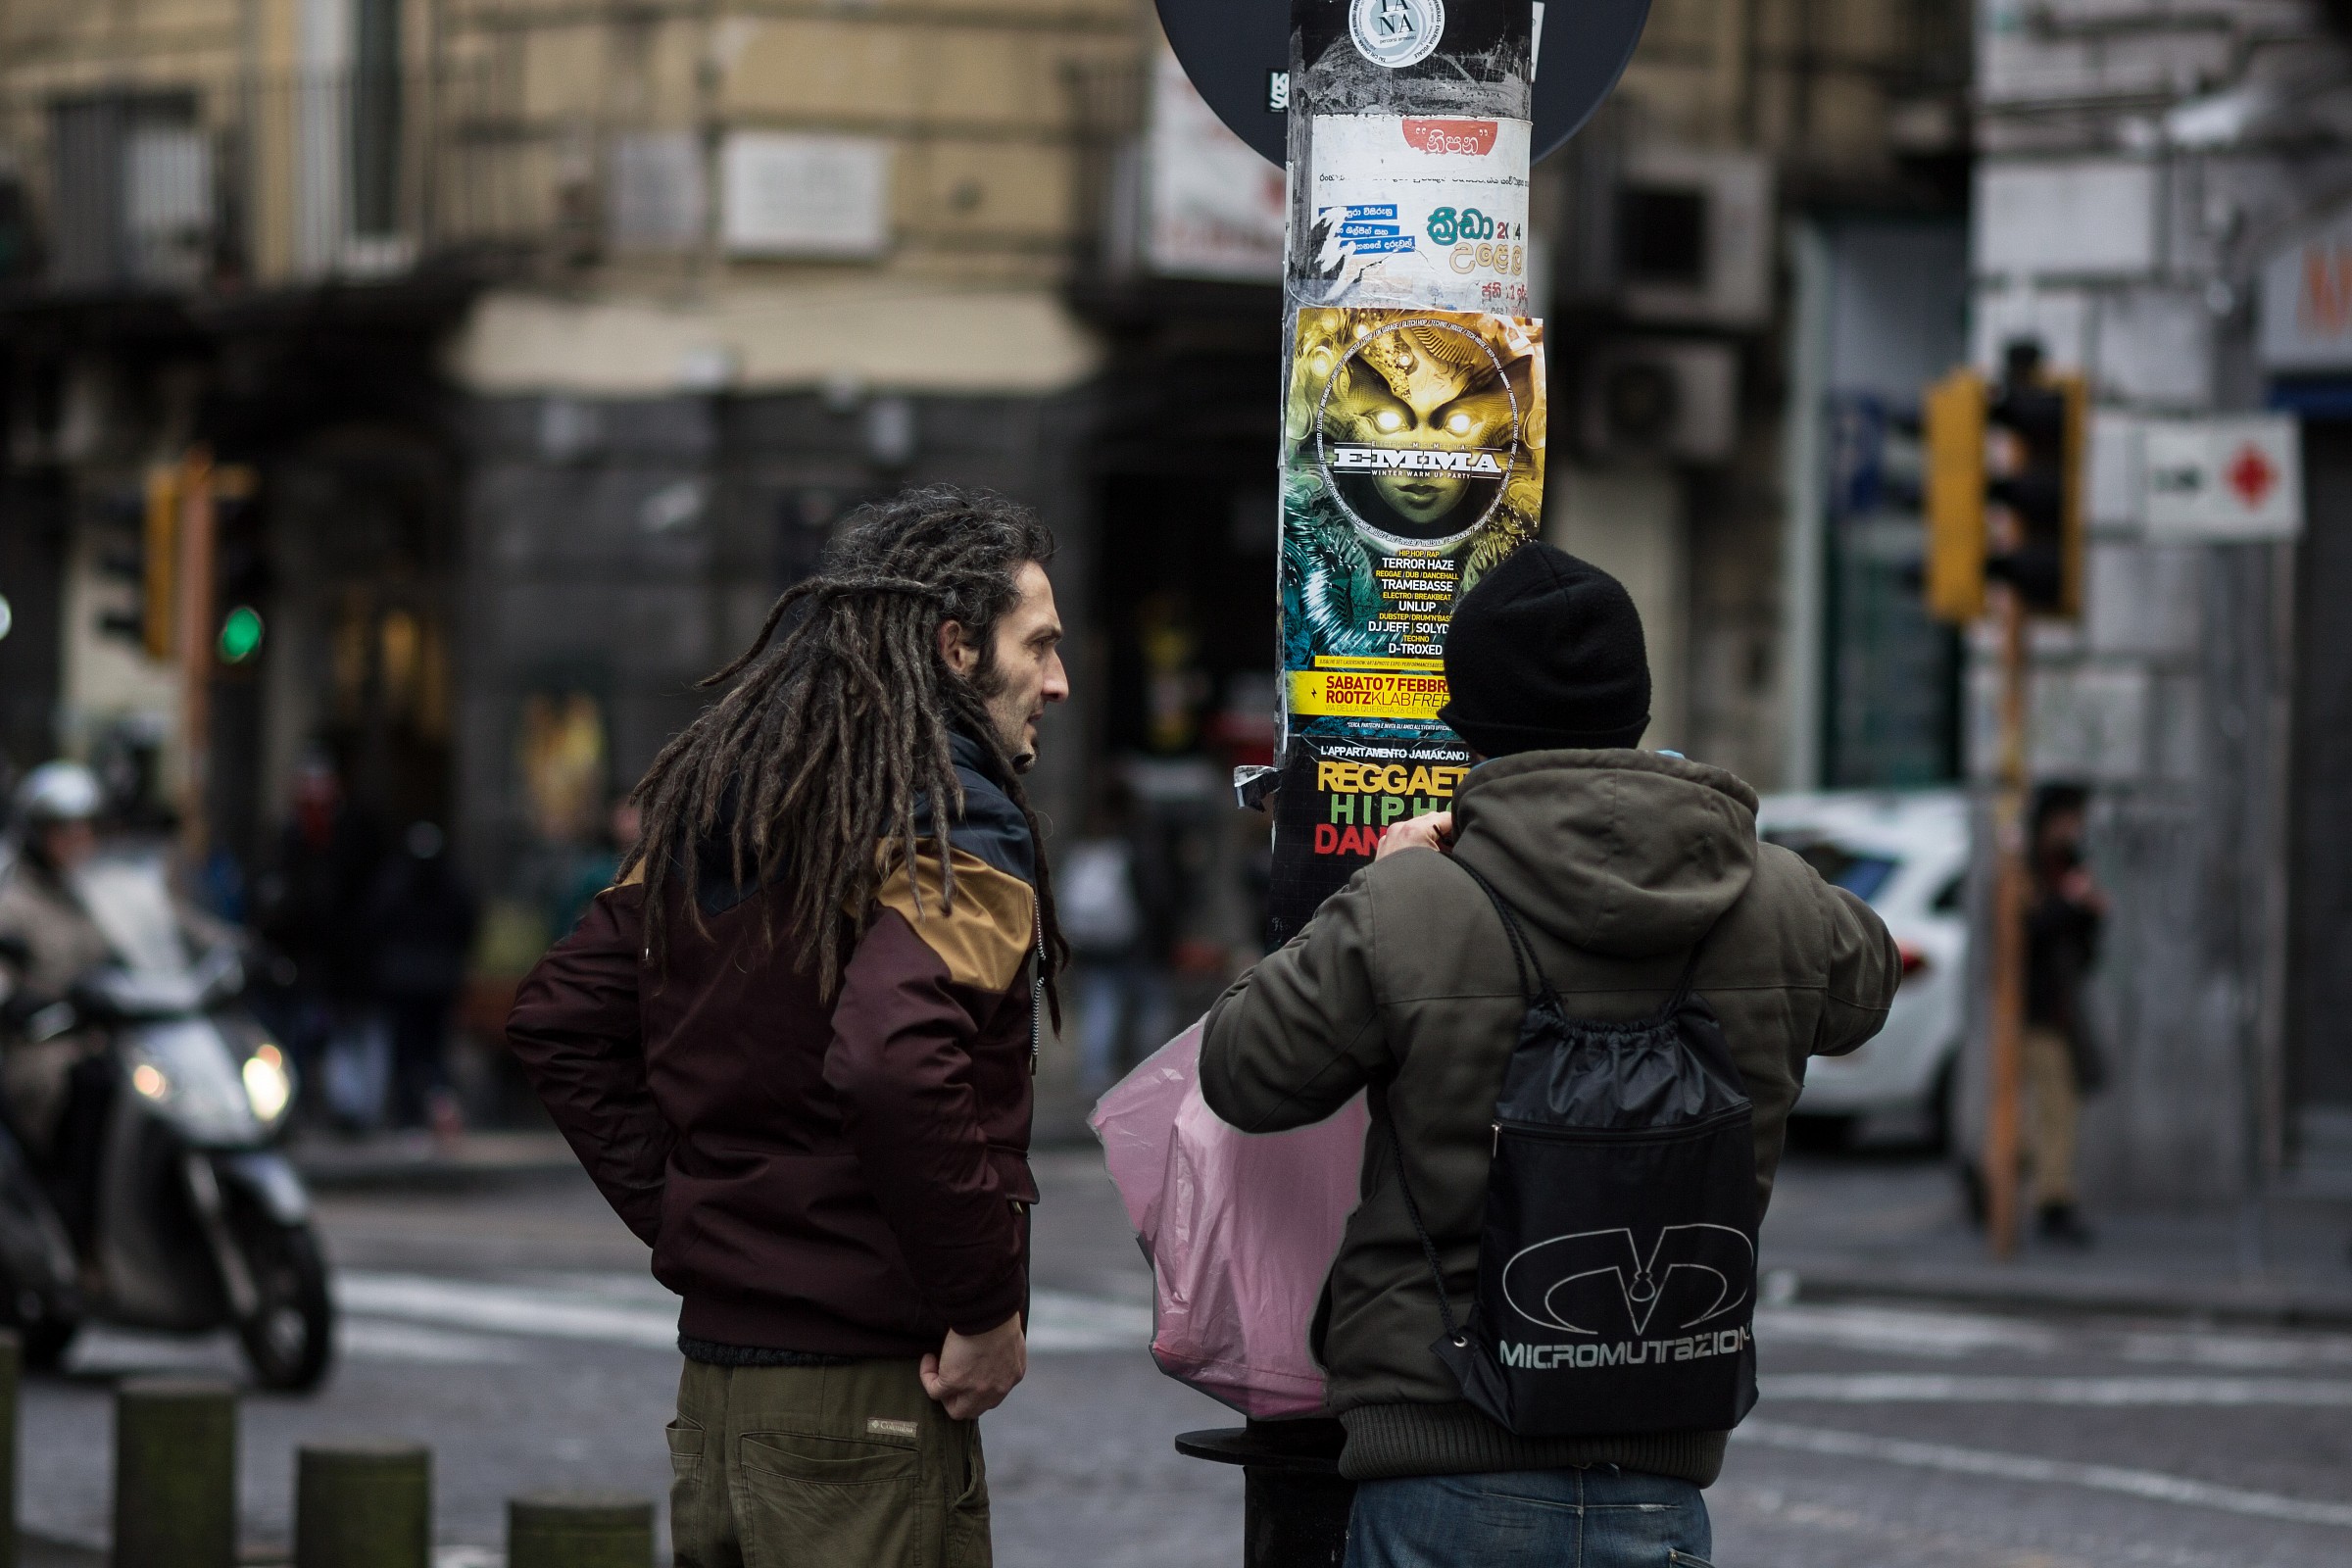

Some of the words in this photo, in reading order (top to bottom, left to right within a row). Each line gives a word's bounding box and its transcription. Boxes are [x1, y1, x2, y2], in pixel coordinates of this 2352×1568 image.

[1377, 13, 1415, 36] NA
[1334, 448, 1501, 473] EMMA
[1382, 558, 1425, 568] TERROR
[1427, 560, 1454, 570] HAZE
[1423, 571, 1459, 580] DANCEHALL
[1382, 578, 1453, 592] TRAMEBASSE
[1398, 601, 1437, 612] UNLUP
[1379, 612, 1409, 621] DUBSTEP
[1368, 621, 1382, 632] DJ
[1383, 621, 1410, 633] JEFF
[1389, 643, 1443, 656] D-TROXED
[1326, 675, 1384, 691] SABATO
[1386, 677, 1395, 691] 7
[1397, 678, 1448, 693] FEBBR
[1412, 693, 1450, 708] FREE
[1321, 746, 1407, 759] L'APPARTAMENTO
[1408, 749, 1465, 760] JAMAICANO
[1331, 794, 1451, 826] HIPH
